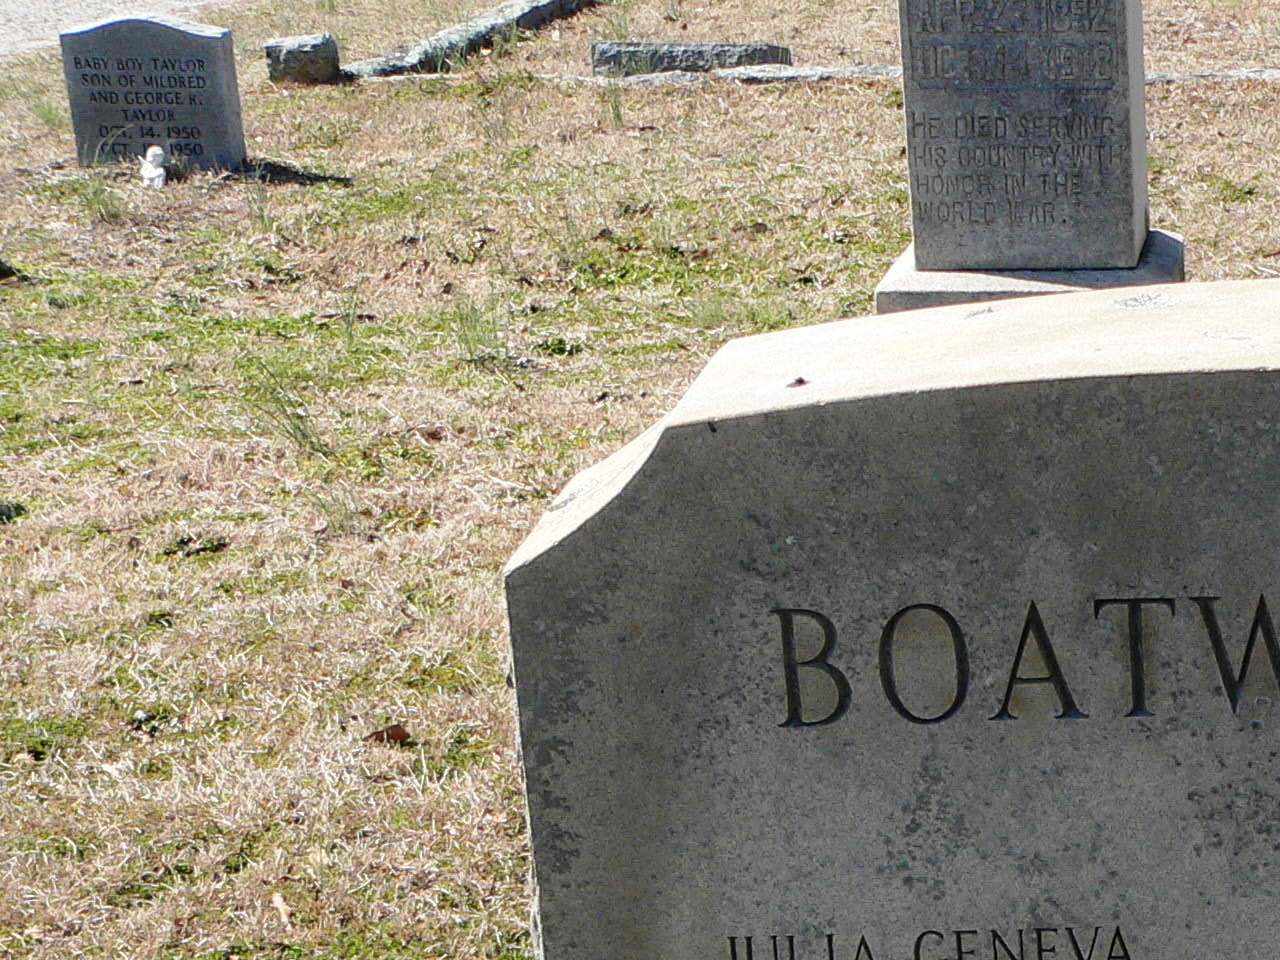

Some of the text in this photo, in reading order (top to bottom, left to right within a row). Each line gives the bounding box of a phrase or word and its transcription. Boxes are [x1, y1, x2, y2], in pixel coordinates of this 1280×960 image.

[74, 56, 206, 72] BABY BOY TAYLOR
[81, 73, 207, 89] SON OF MILDRED
[89, 91, 120, 105] AND
[124, 91, 184, 105] GEORGE
[120, 109, 177, 122] TAYLOR
[167, 126, 201, 140] 1950
[911, 112, 1115, 140] HE DIED SERVING
[169, 143, 204, 157] 1950
[912, 144, 947, 169] HIS
[957, 144, 1062, 169] COUNTRY
[916, 172, 1082, 197] HONOR IN THE
[917, 201, 997, 225] WORLD
